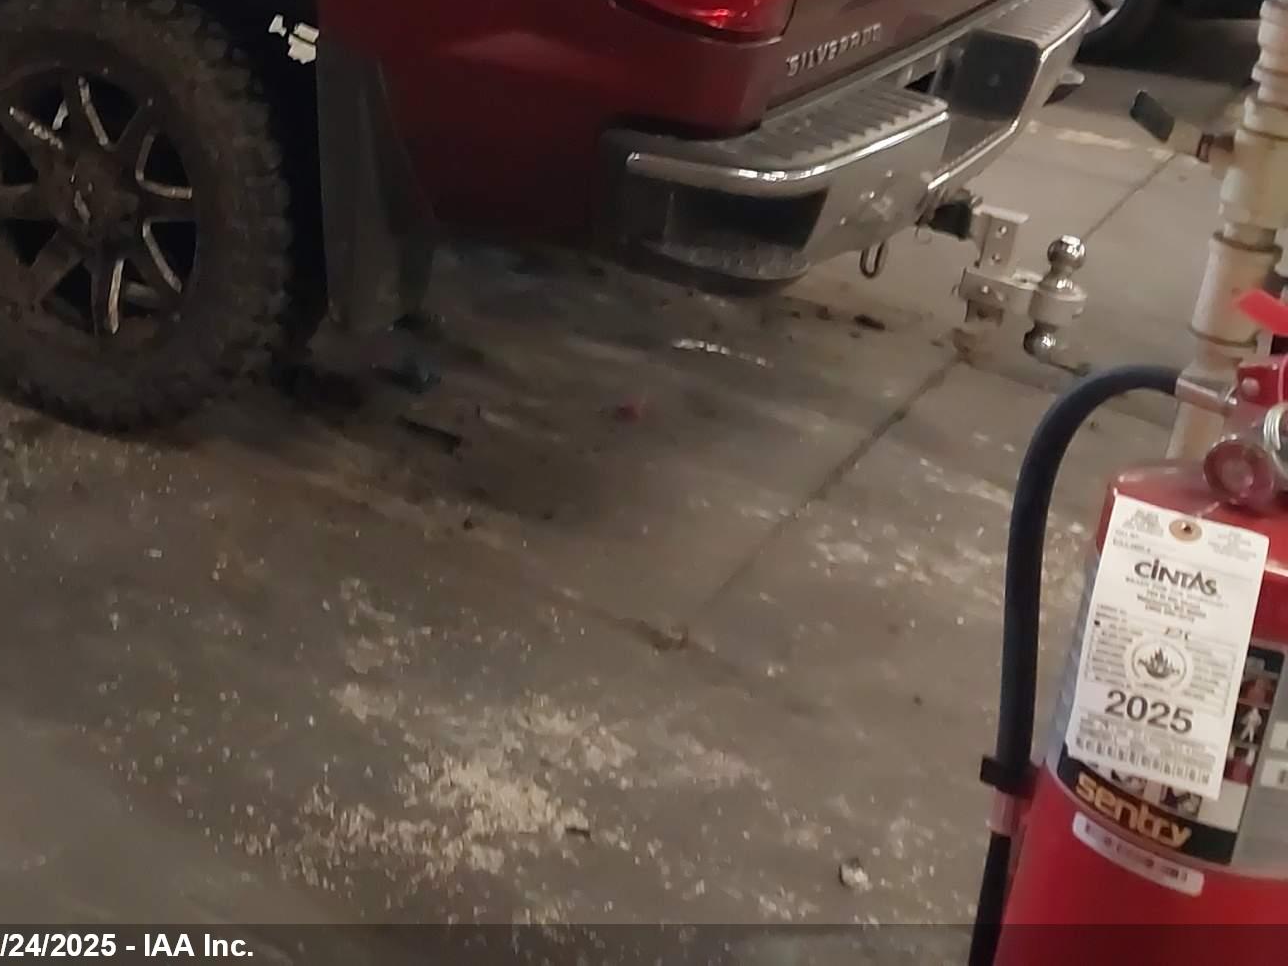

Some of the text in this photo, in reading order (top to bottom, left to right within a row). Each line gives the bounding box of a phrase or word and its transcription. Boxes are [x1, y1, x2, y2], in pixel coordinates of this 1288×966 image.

[1134, 558, 1219, 597] CINTAS
[1104, 689, 1195, 735] 2025
[1075, 771, 1193, 850] sentry
